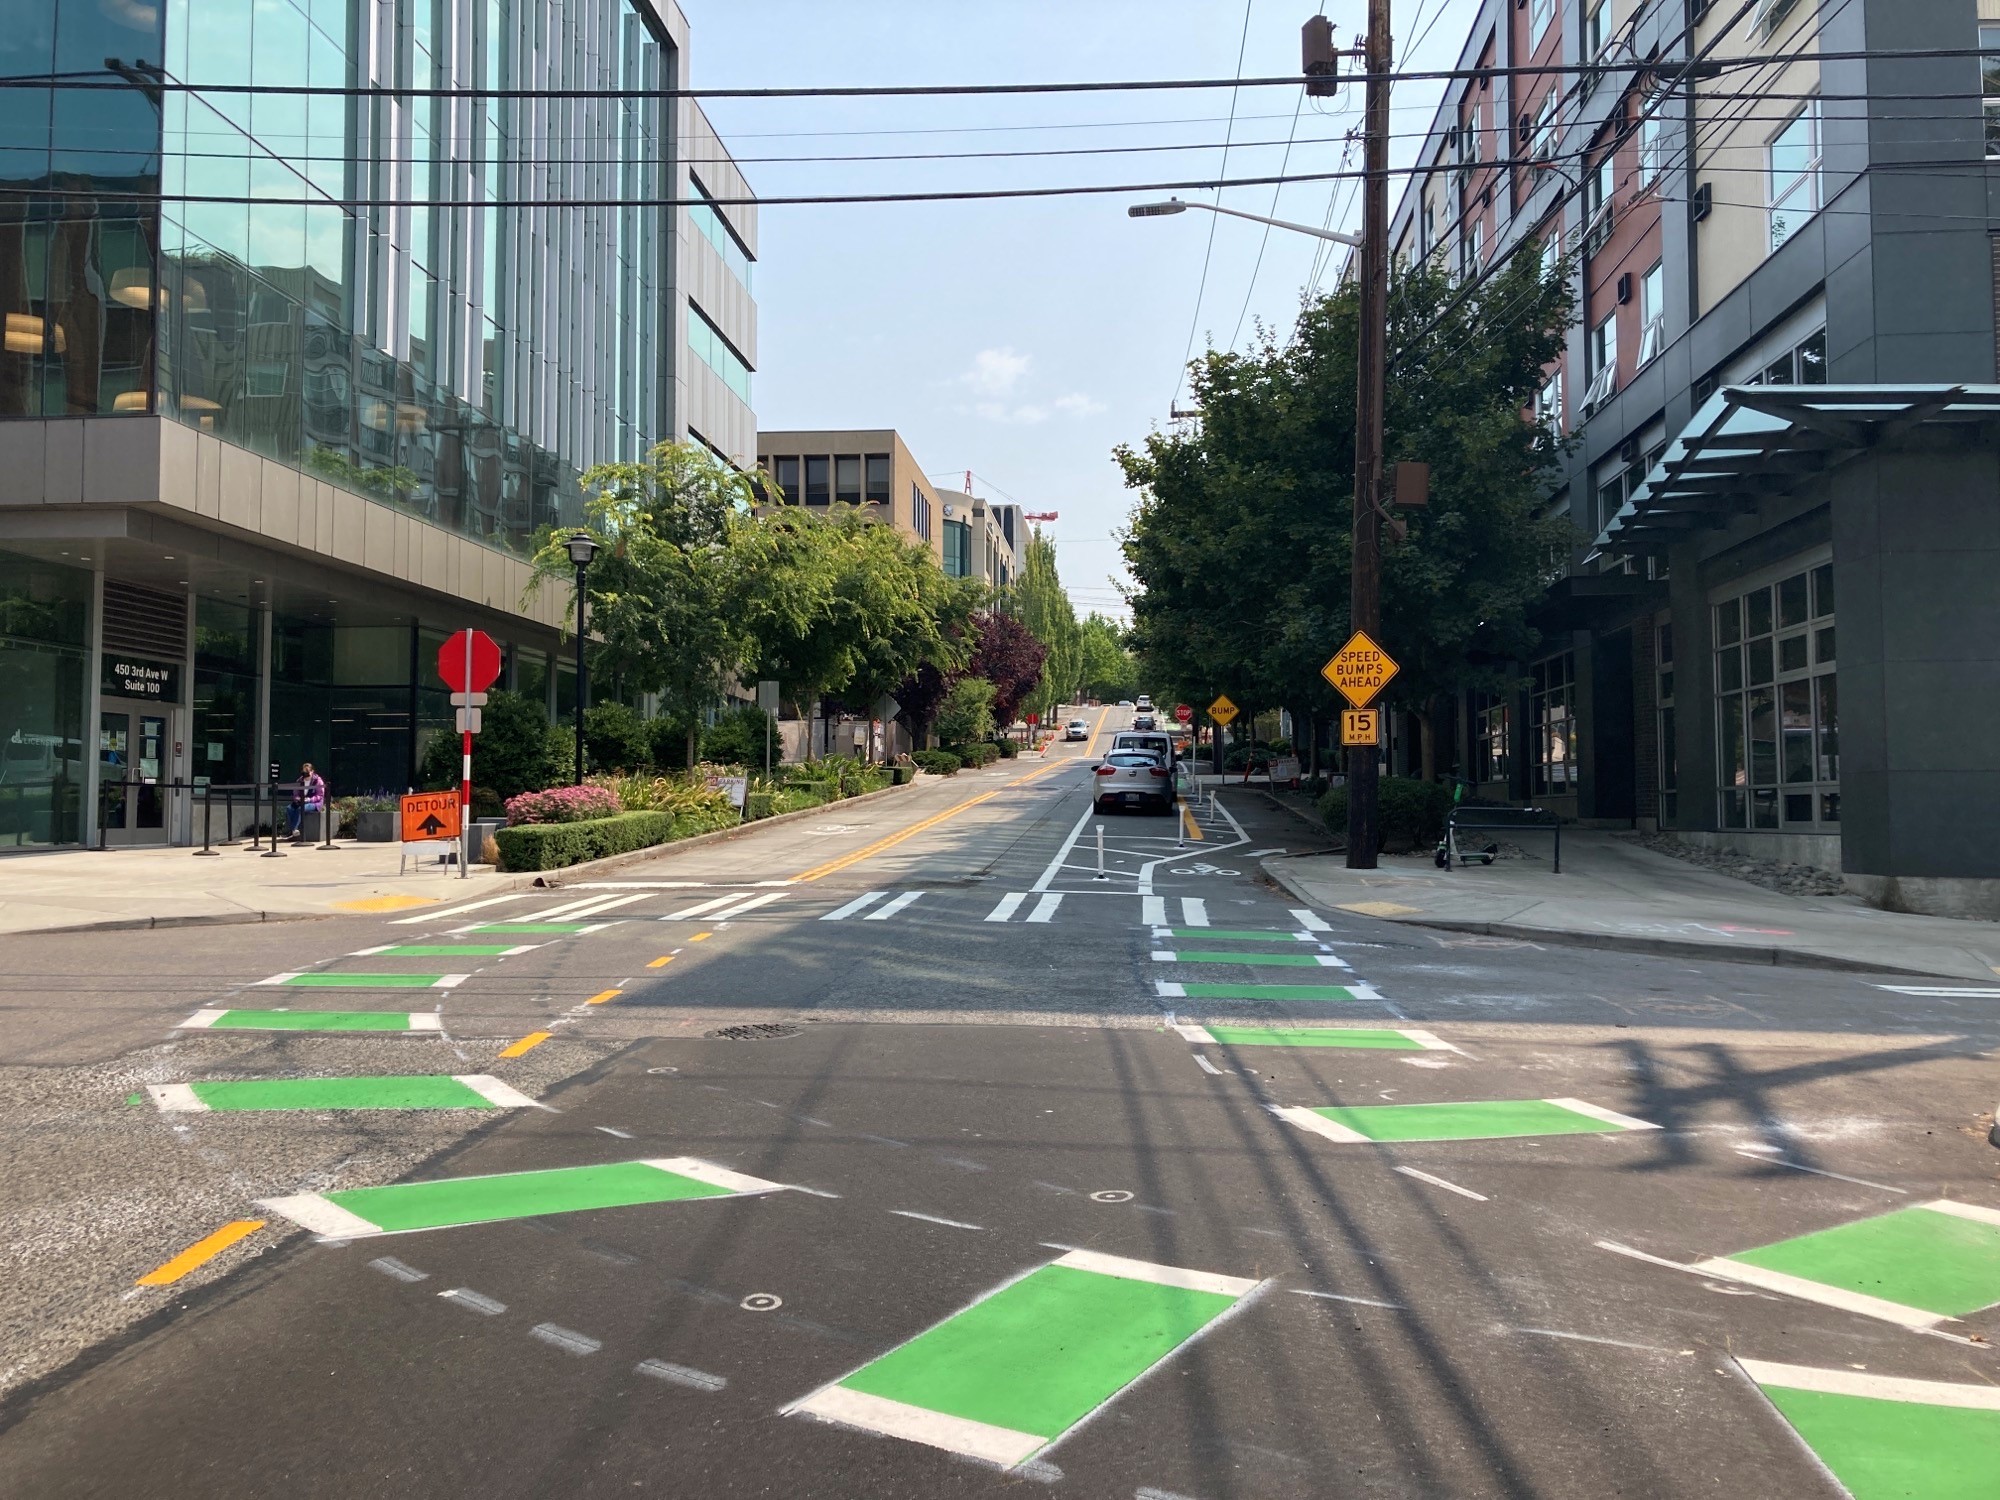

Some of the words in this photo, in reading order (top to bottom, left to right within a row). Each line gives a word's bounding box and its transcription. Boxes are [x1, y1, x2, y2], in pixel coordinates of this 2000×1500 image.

[1341, 651, 1380, 662] SPEED
[114, 663, 130, 675] 450
[131, 665, 144, 678] 3rd
[145, 667, 159, 680] Ave
[161, 669, 169, 681] W
[1337, 664, 1383, 675] BUMPS
[124, 679, 145, 692] Suite
[146, 681, 160, 693] 100
[1340, 676, 1381, 687] AHEAD
[1211, 706, 1235, 715] BUMP
[1349, 715, 1371, 731] 15
[407, 798, 455, 813] DETOUR
